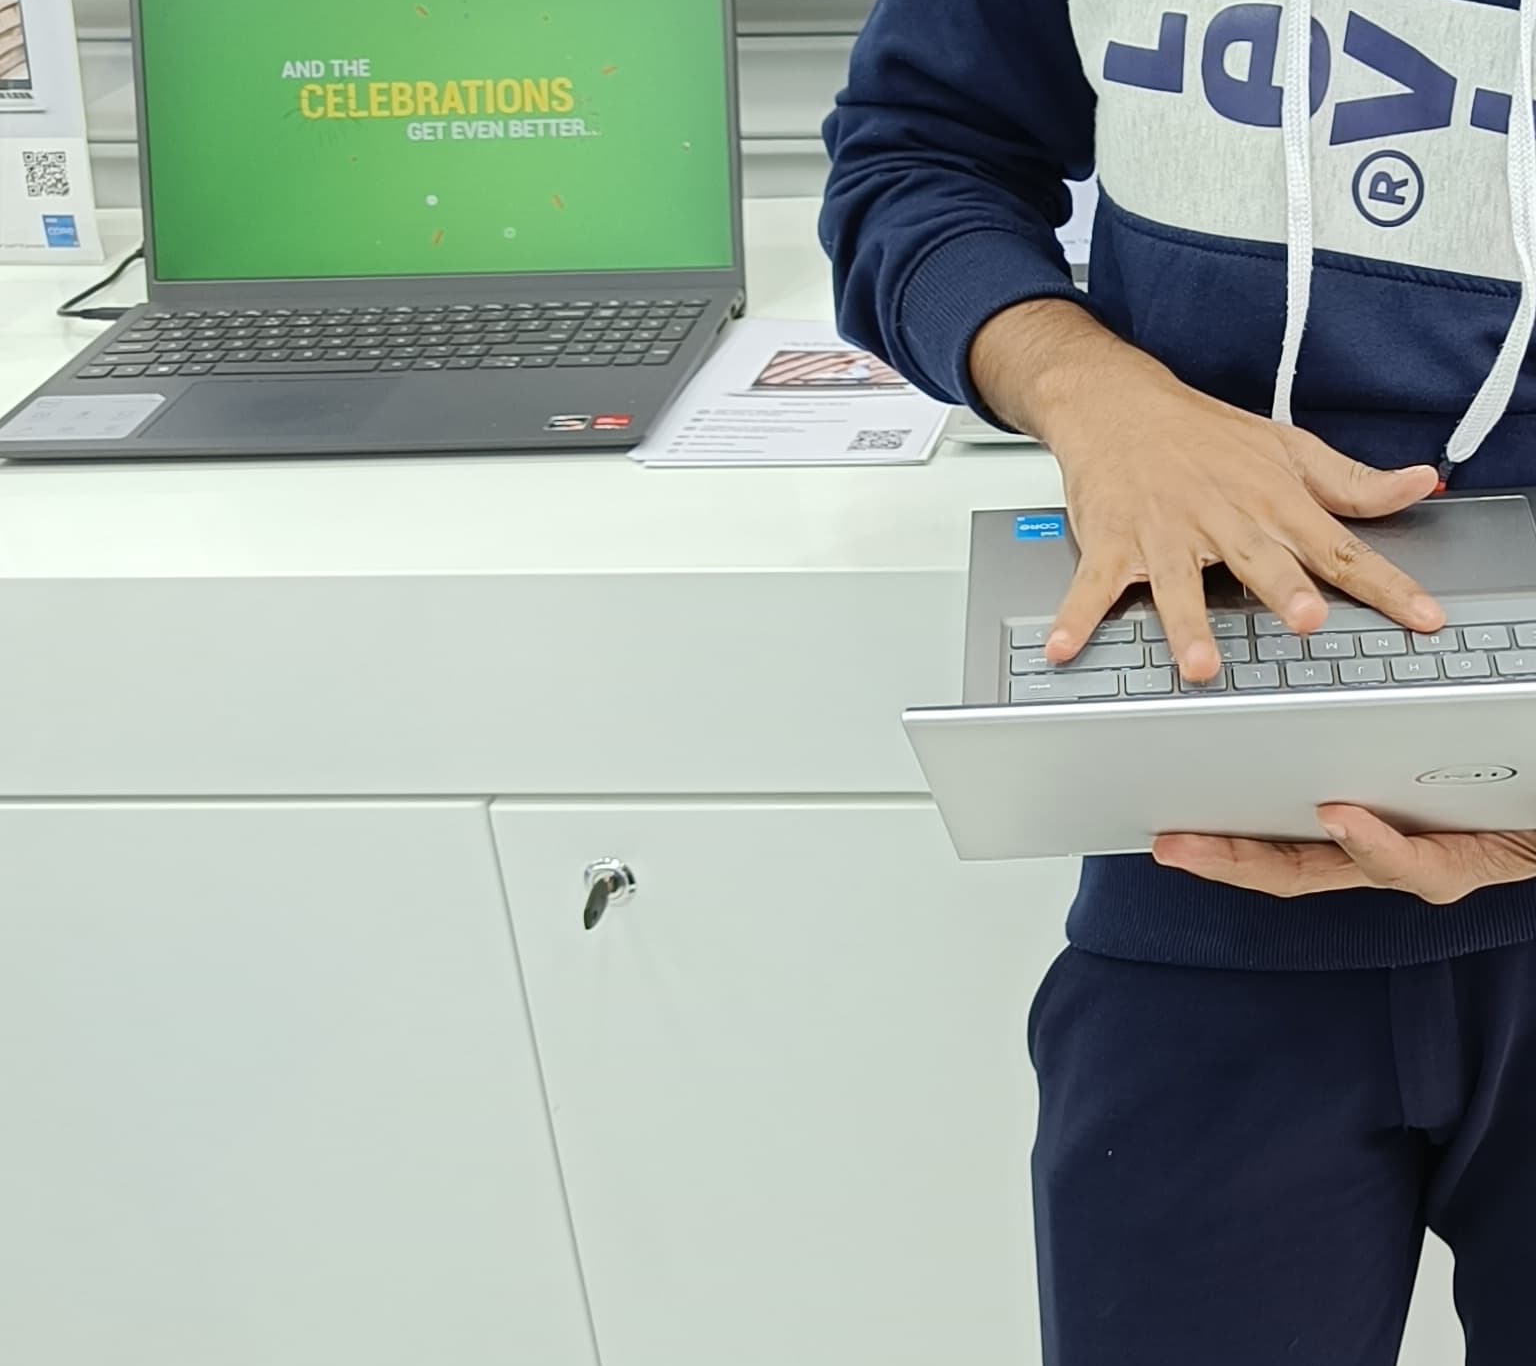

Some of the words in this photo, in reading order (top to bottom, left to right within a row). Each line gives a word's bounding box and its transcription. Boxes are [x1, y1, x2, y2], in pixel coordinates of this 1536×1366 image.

[282, 60, 325, 79] AND
[329, 59, 370, 77] THE
[301, 77, 575, 119] CELEBRATIONS
[407, 122, 446, 141] GET
[451, 120, 504, 140] EVEN
